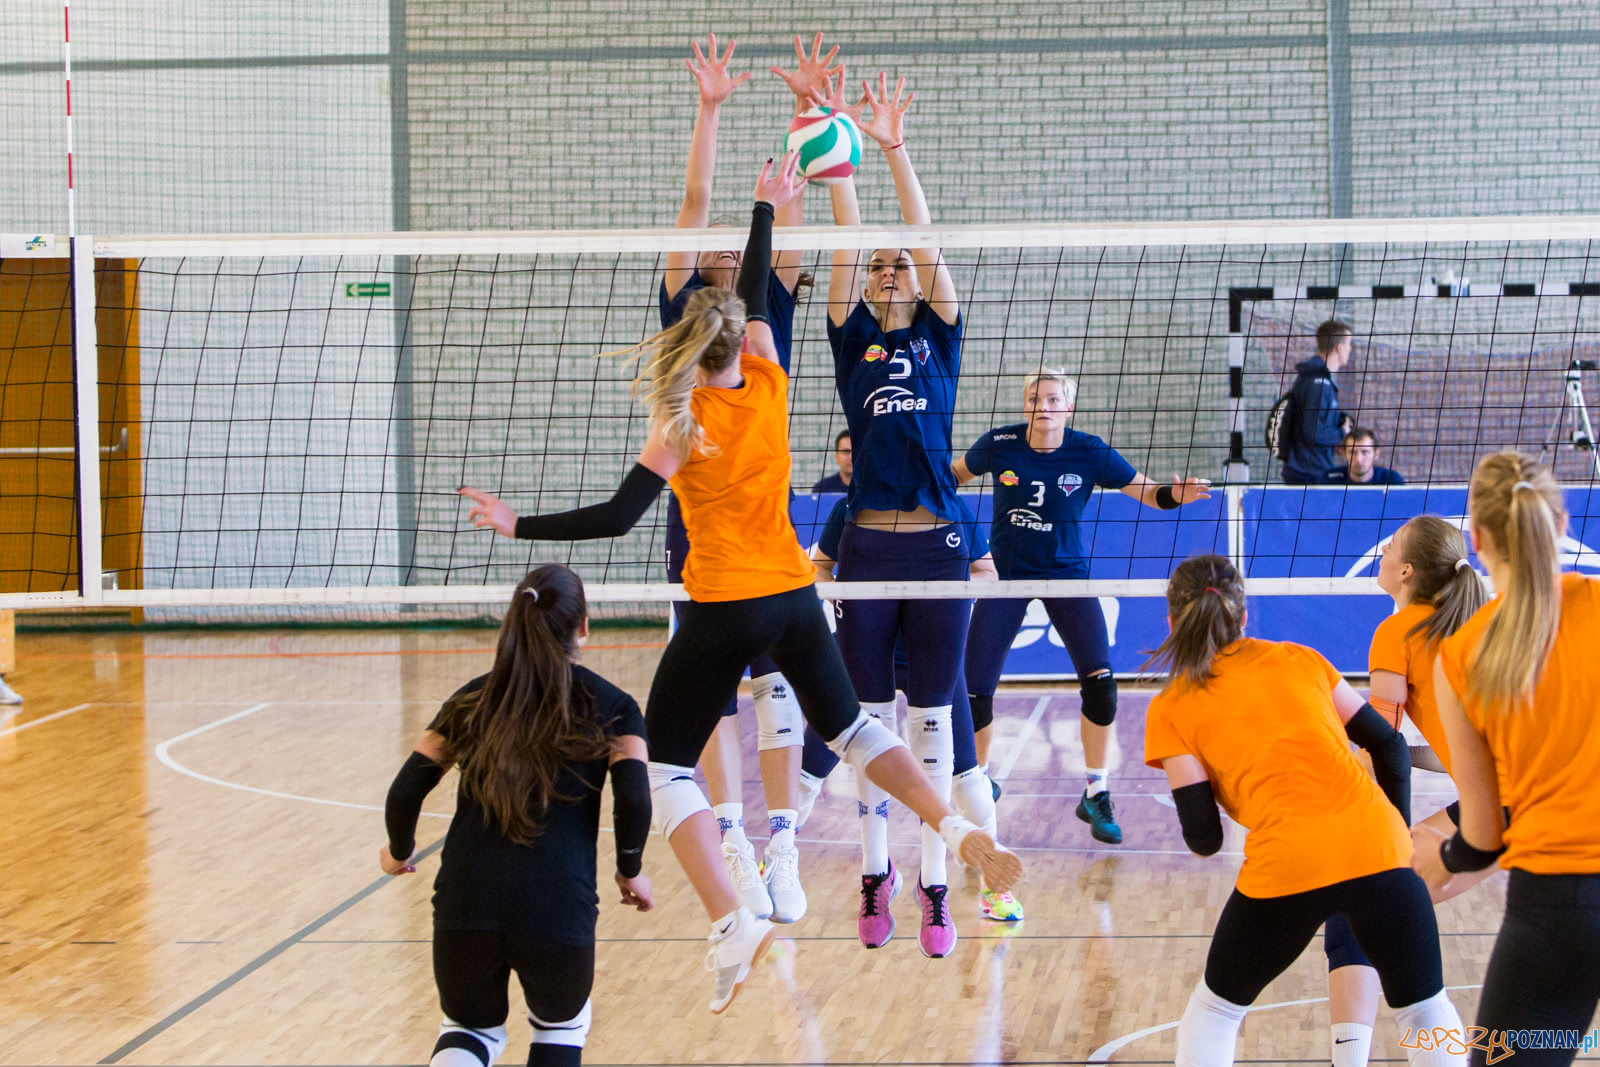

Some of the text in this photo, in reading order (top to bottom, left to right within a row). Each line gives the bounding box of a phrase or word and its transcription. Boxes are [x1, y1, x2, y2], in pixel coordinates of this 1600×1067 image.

[888, 349, 912, 379] 5
[873, 397, 928, 416] Enea
[1028, 480, 1046, 507] 3
[1010, 513, 1053, 532] Enea
[835, 600, 843, 618] 5
